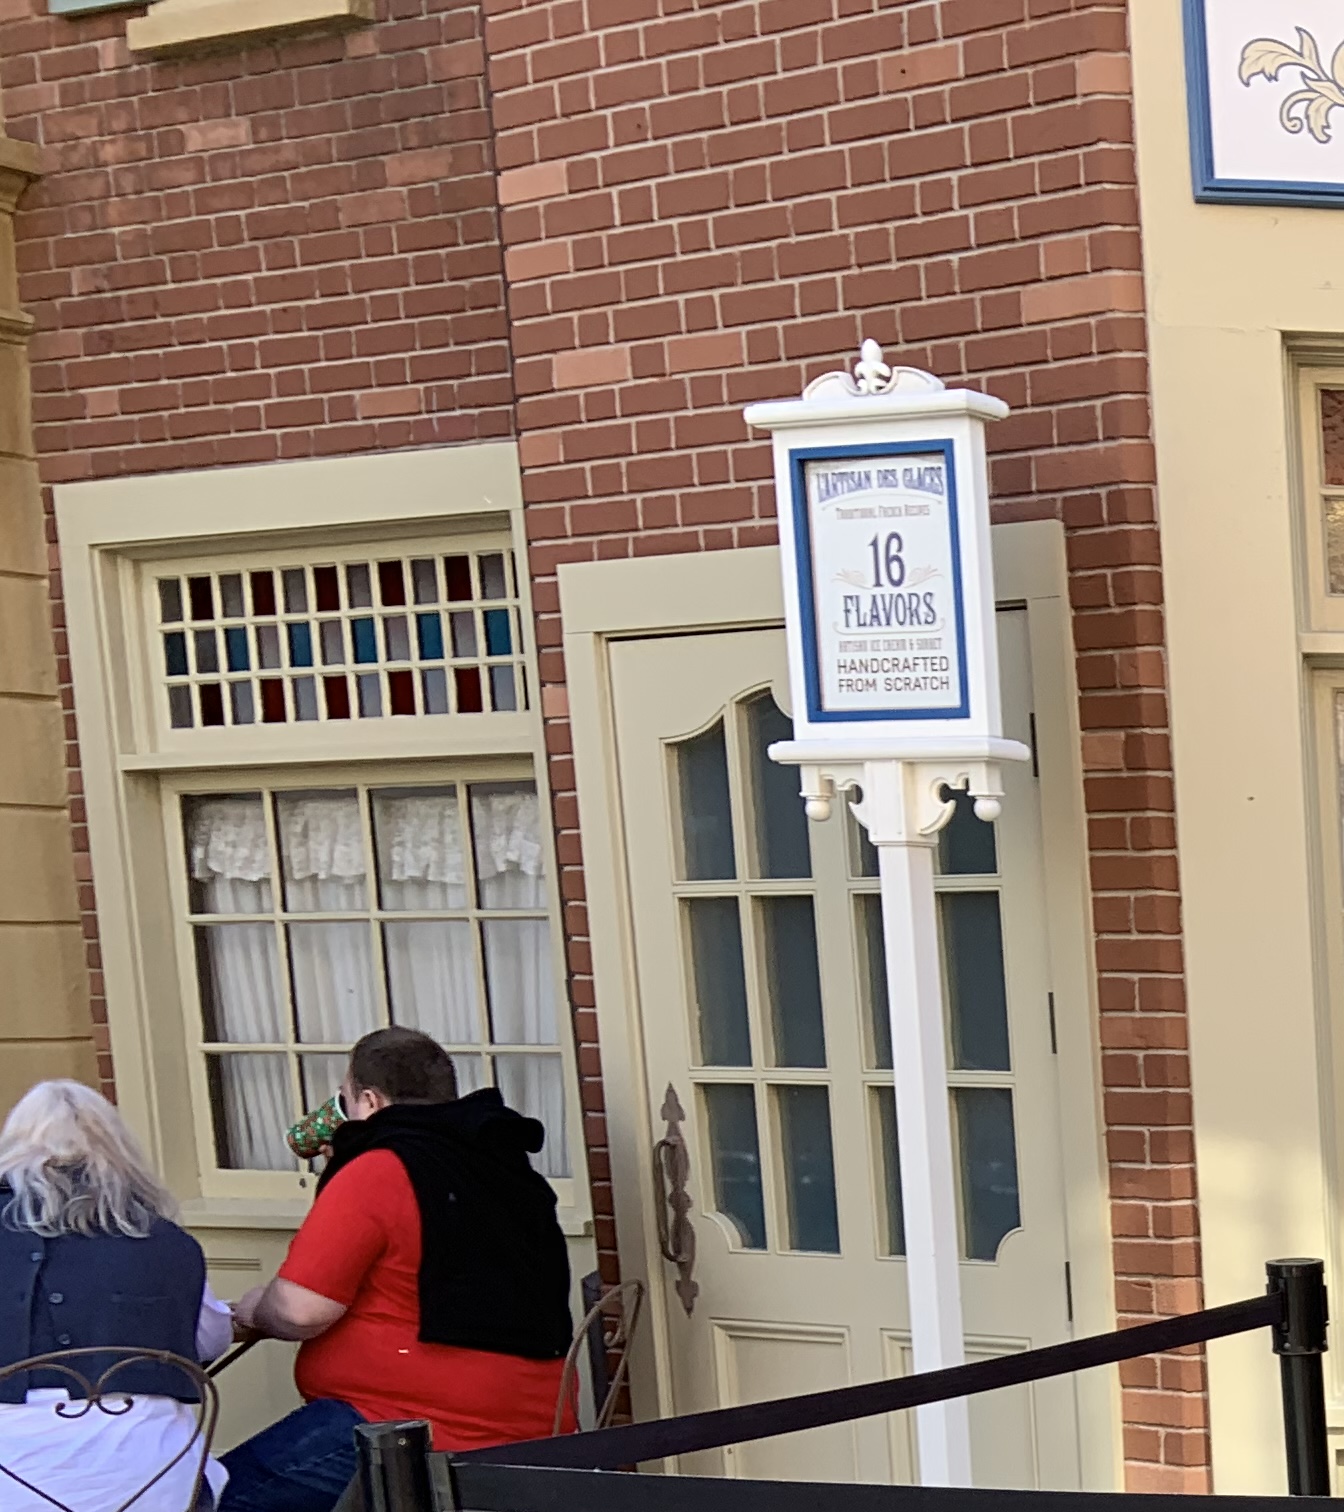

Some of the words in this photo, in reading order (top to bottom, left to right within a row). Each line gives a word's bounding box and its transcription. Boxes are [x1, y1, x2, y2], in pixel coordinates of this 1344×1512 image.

[876, 467, 898, 488] DES
[867, 531, 905, 587] 16
[843, 592, 937, 628] FLAVORS
[837, 656, 950, 674] HANDCRAFTED
[839, 678, 878, 693] FROM
[884, 676, 950, 692] SCRATCH
